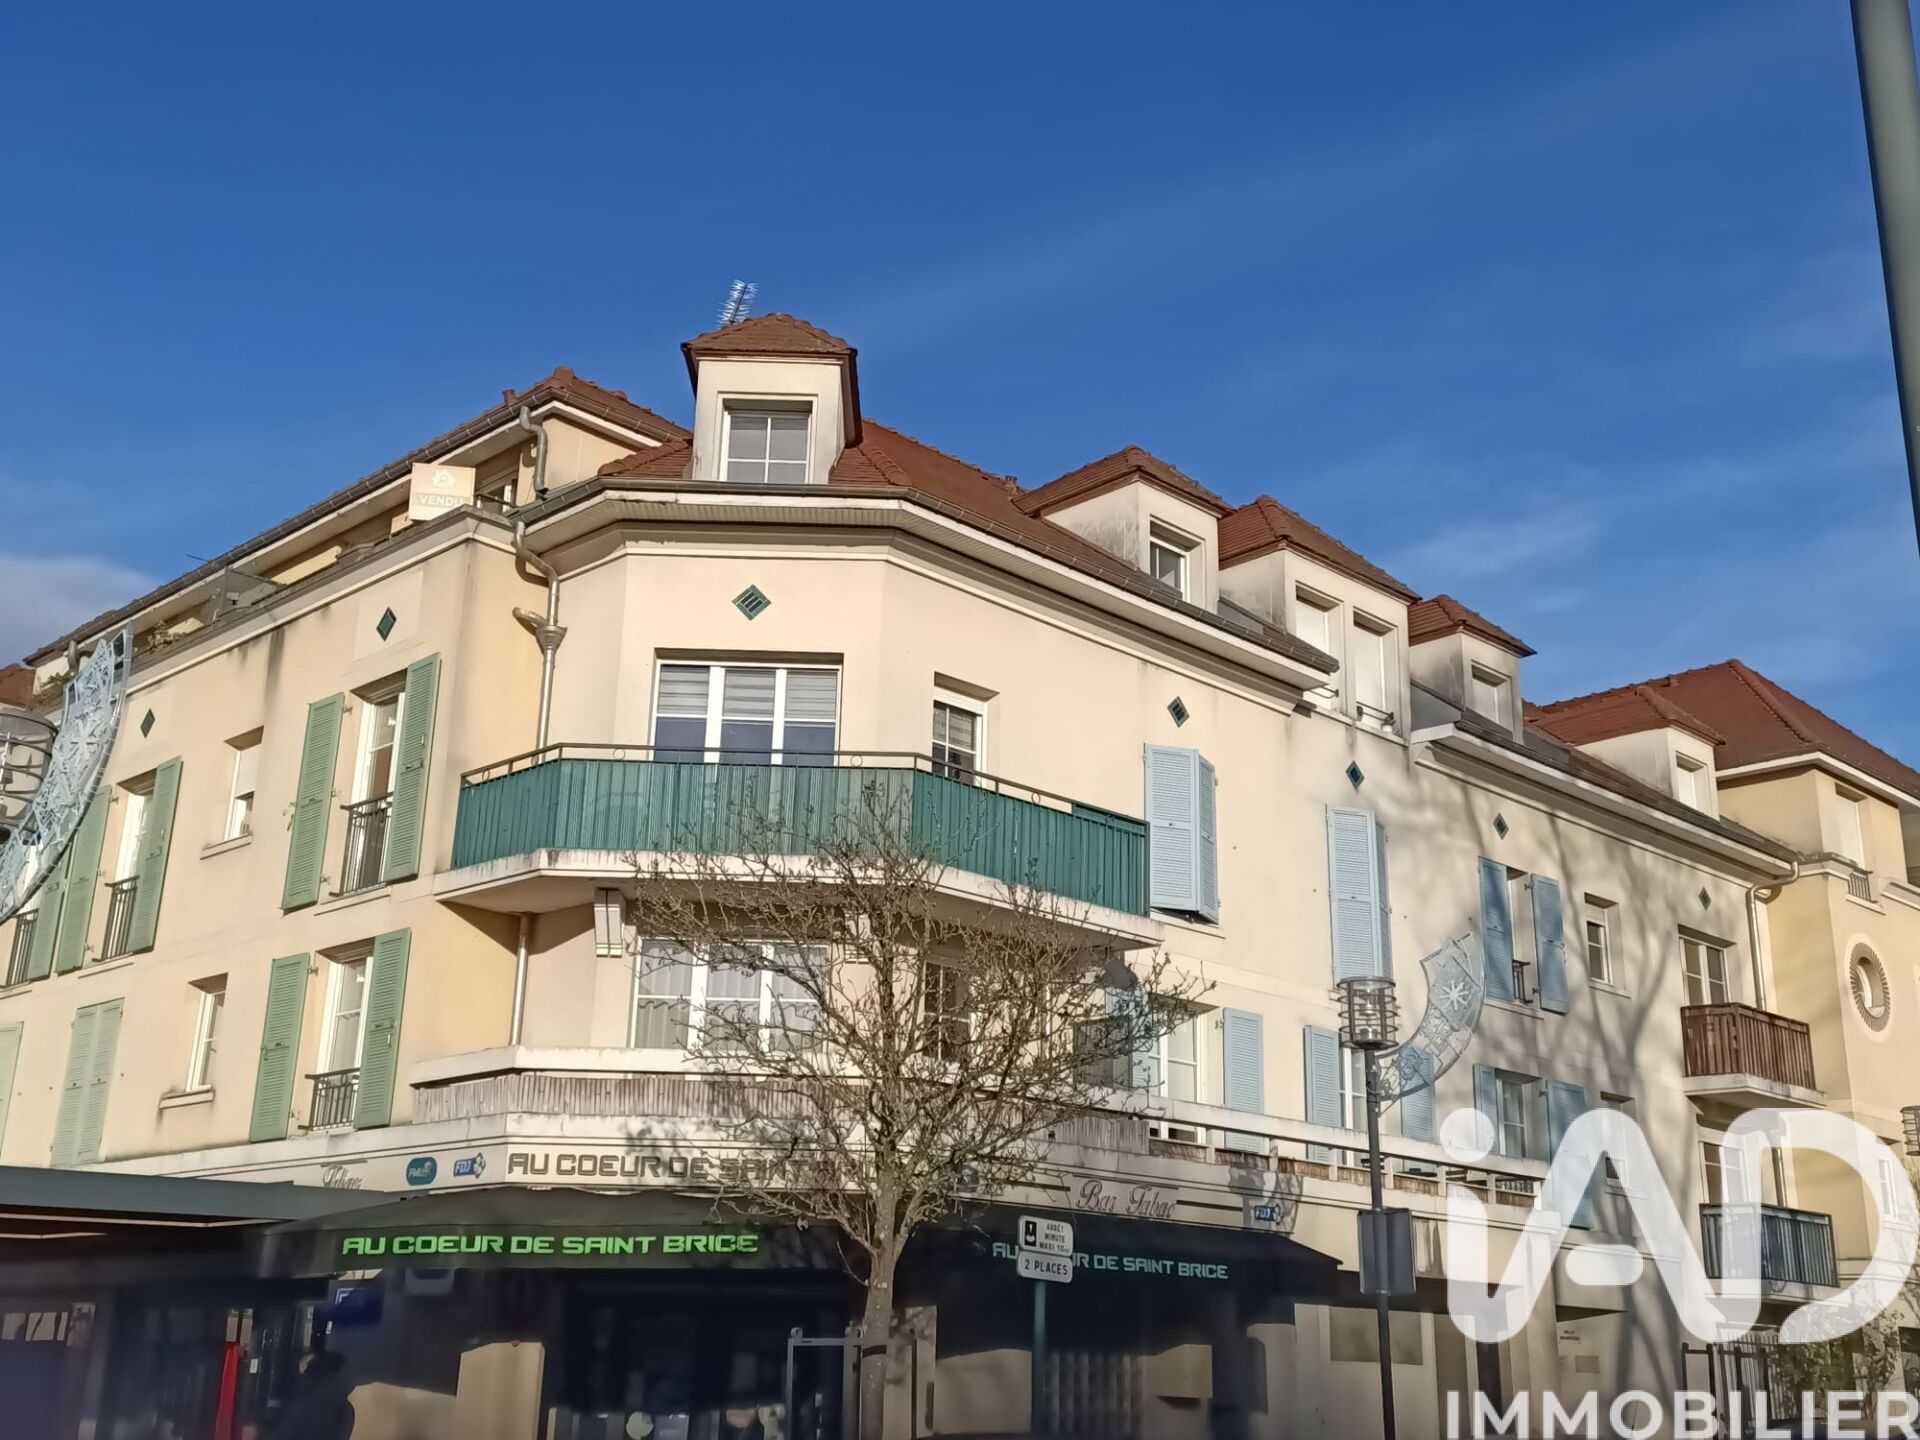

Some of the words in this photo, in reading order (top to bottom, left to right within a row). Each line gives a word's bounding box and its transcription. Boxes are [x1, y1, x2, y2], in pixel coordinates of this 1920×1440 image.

[455, 1160, 472, 1173] FDJ
[508, 1153, 549, 1175] AU
[556, 1154, 661, 1177] COEUR
[668, 1156, 711, 1178] DE
[1126, 1185, 1176, 1218] Tabac
[1256, 1208, 1272, 1220] FDJ
[342, 1236, 386, 1255] AU
[393, 1235, 504, 1255] COEUR
[510, 1236, 555, 1254] DE
[562, 1236, 657, 1255] SAINT
[663, 1234, 759, 1254] BRICE
[1044, 1233, 1066, 1244] MINUTE
[992, 1242, 1019, 1260] AU
[1094, 1254, 1119, 1271] DE
[1123, 1257, 1174, 1275] SAINT
[1178, 1262, 1229, 1280] BRICE
[1024, 1259, 1030, 1271] 2
[1034, 1260, 1068, 1276] PLACES
